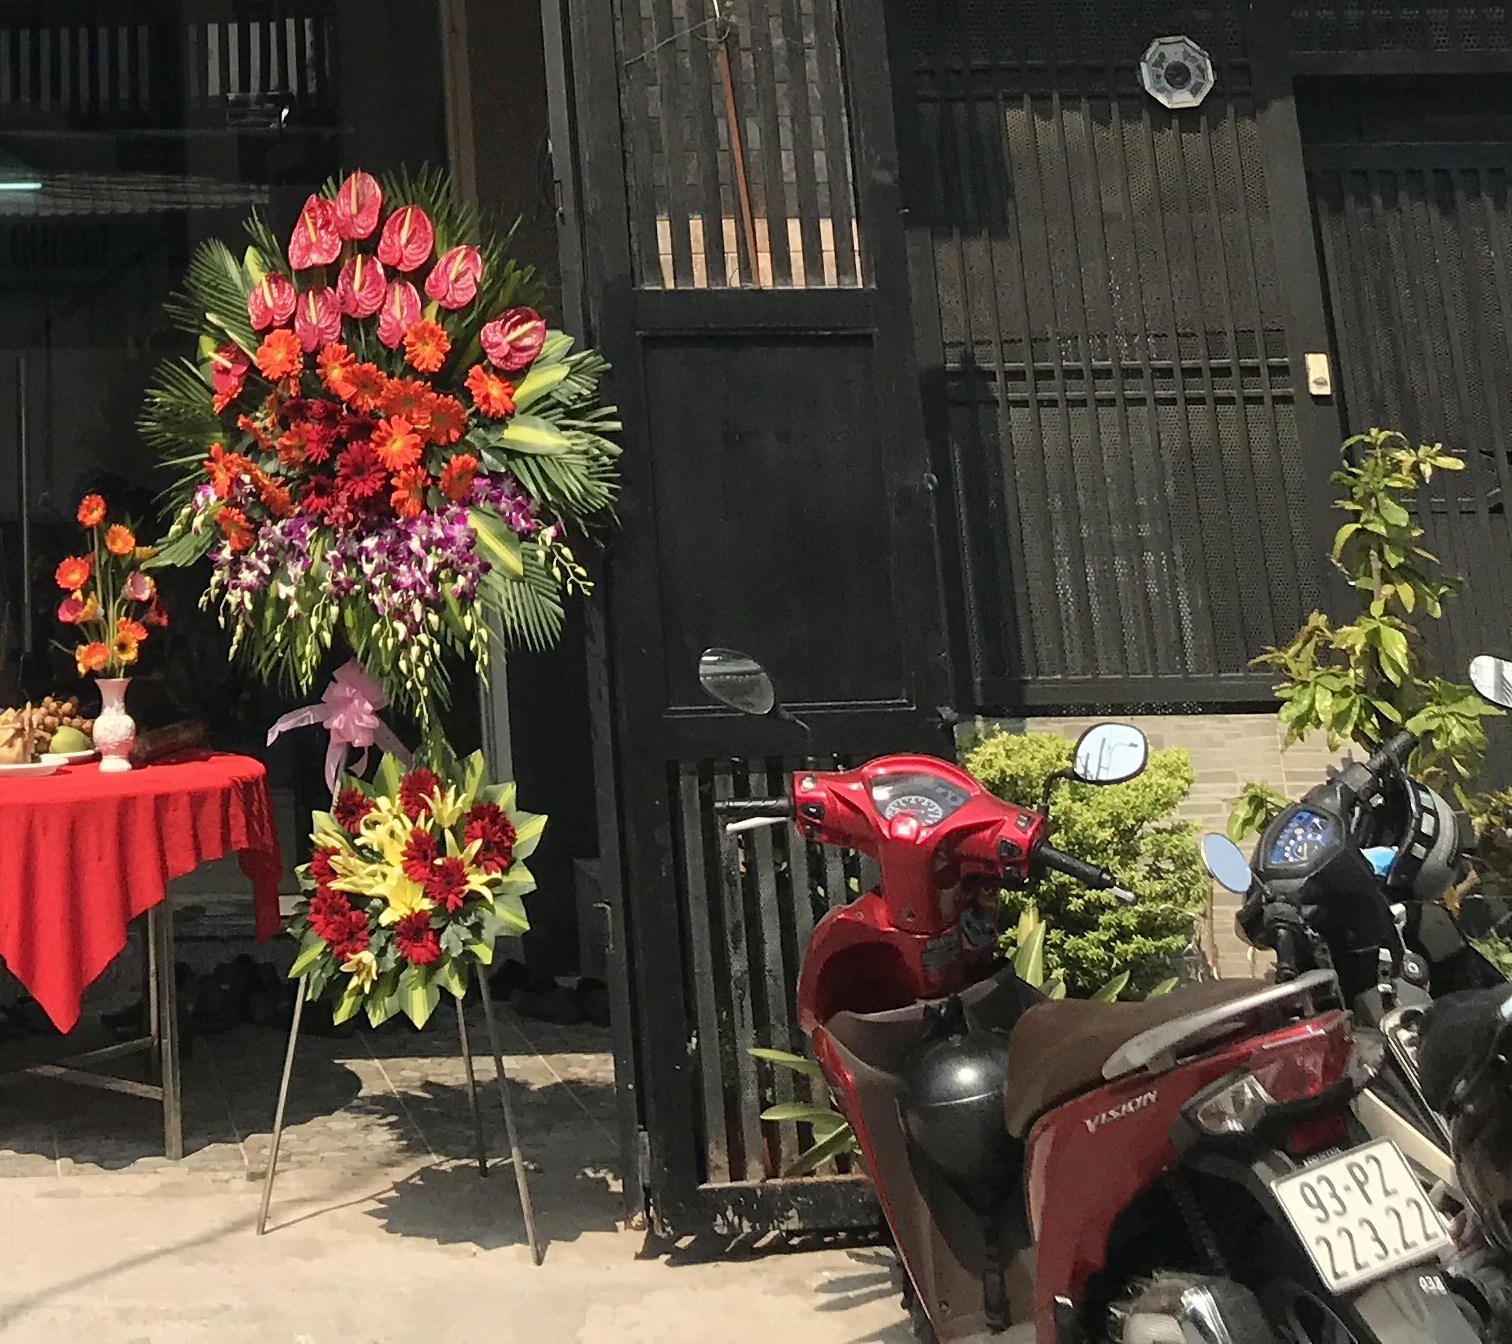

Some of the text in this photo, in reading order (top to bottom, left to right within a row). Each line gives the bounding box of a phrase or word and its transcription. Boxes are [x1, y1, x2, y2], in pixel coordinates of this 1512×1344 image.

[1083, 1090, 1158, 1133] VISION
[1299, 1153, 1399, 1225] 93-P2
[1315, 1196, 1440, 1281] 223.22
